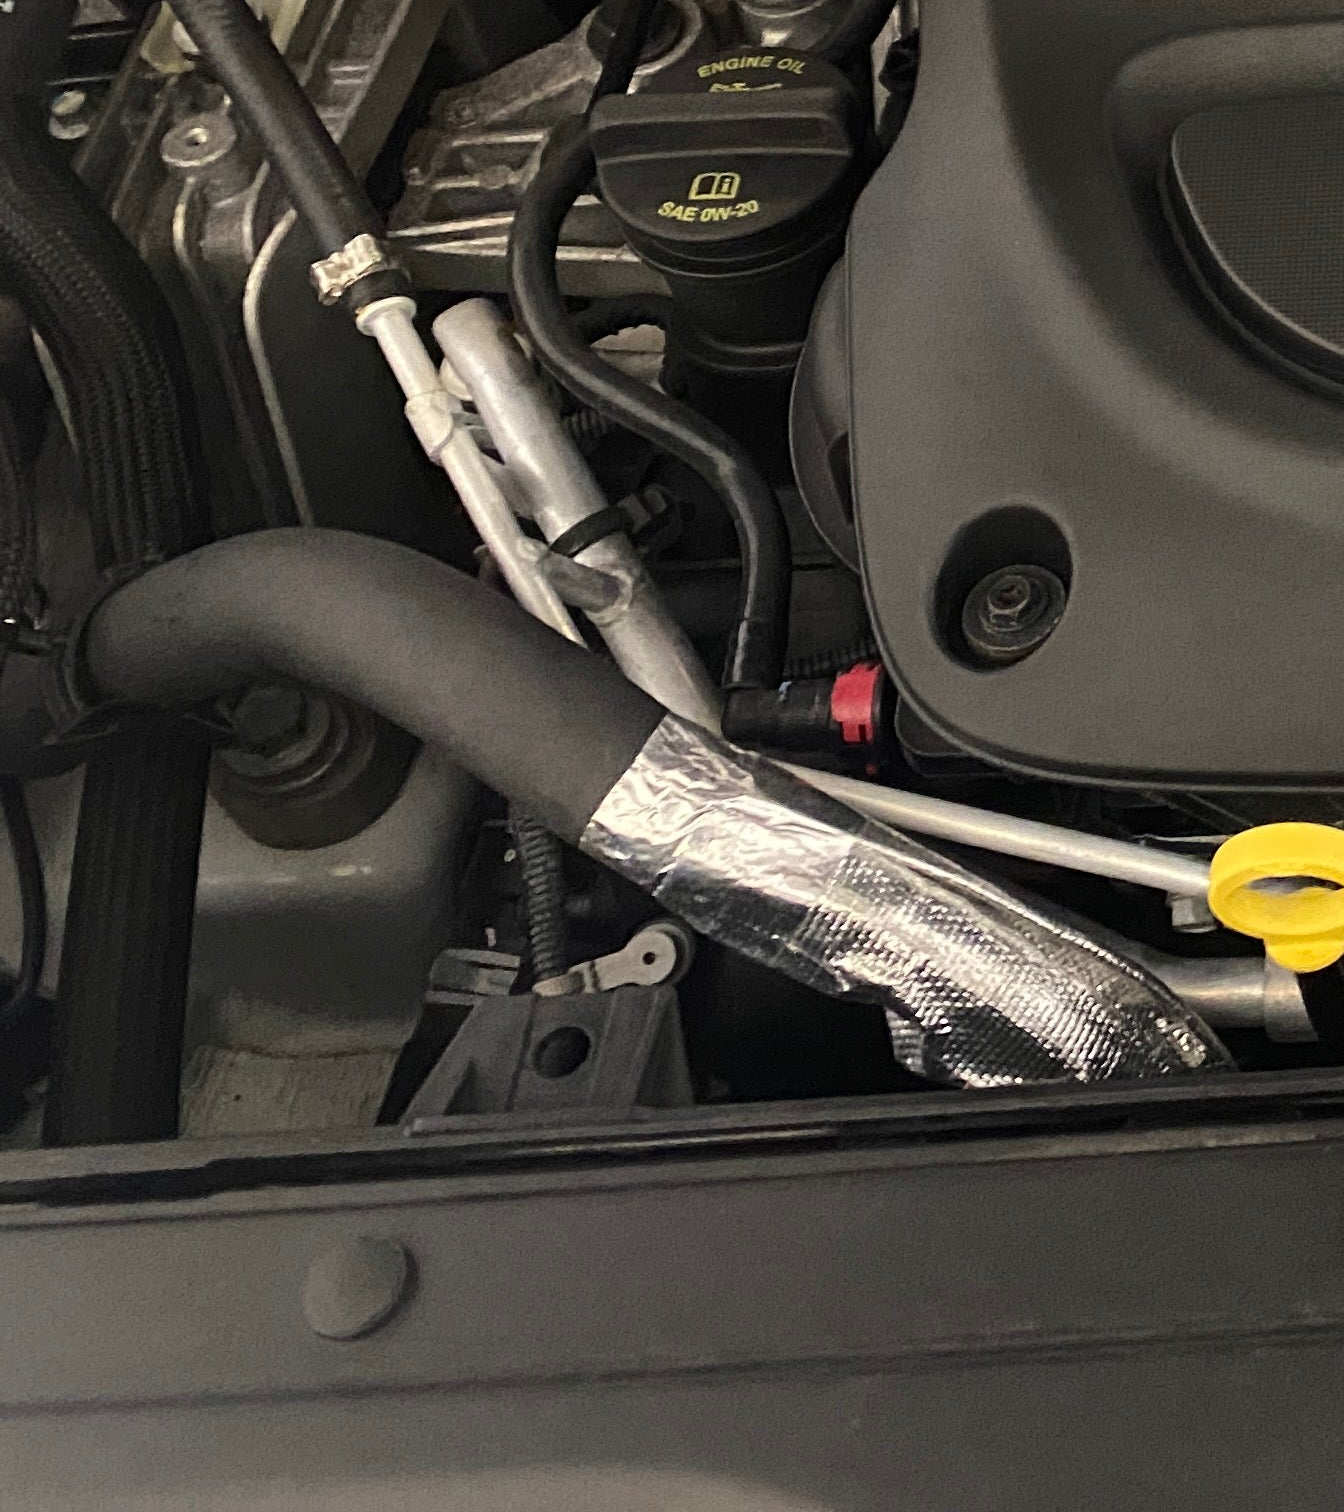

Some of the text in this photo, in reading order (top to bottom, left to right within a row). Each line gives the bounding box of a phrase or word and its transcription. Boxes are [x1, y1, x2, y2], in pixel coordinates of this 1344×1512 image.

[697, 55, 806, 78] ENGINE OIL
[657, 199, 760, 222] SAE 0W-20
